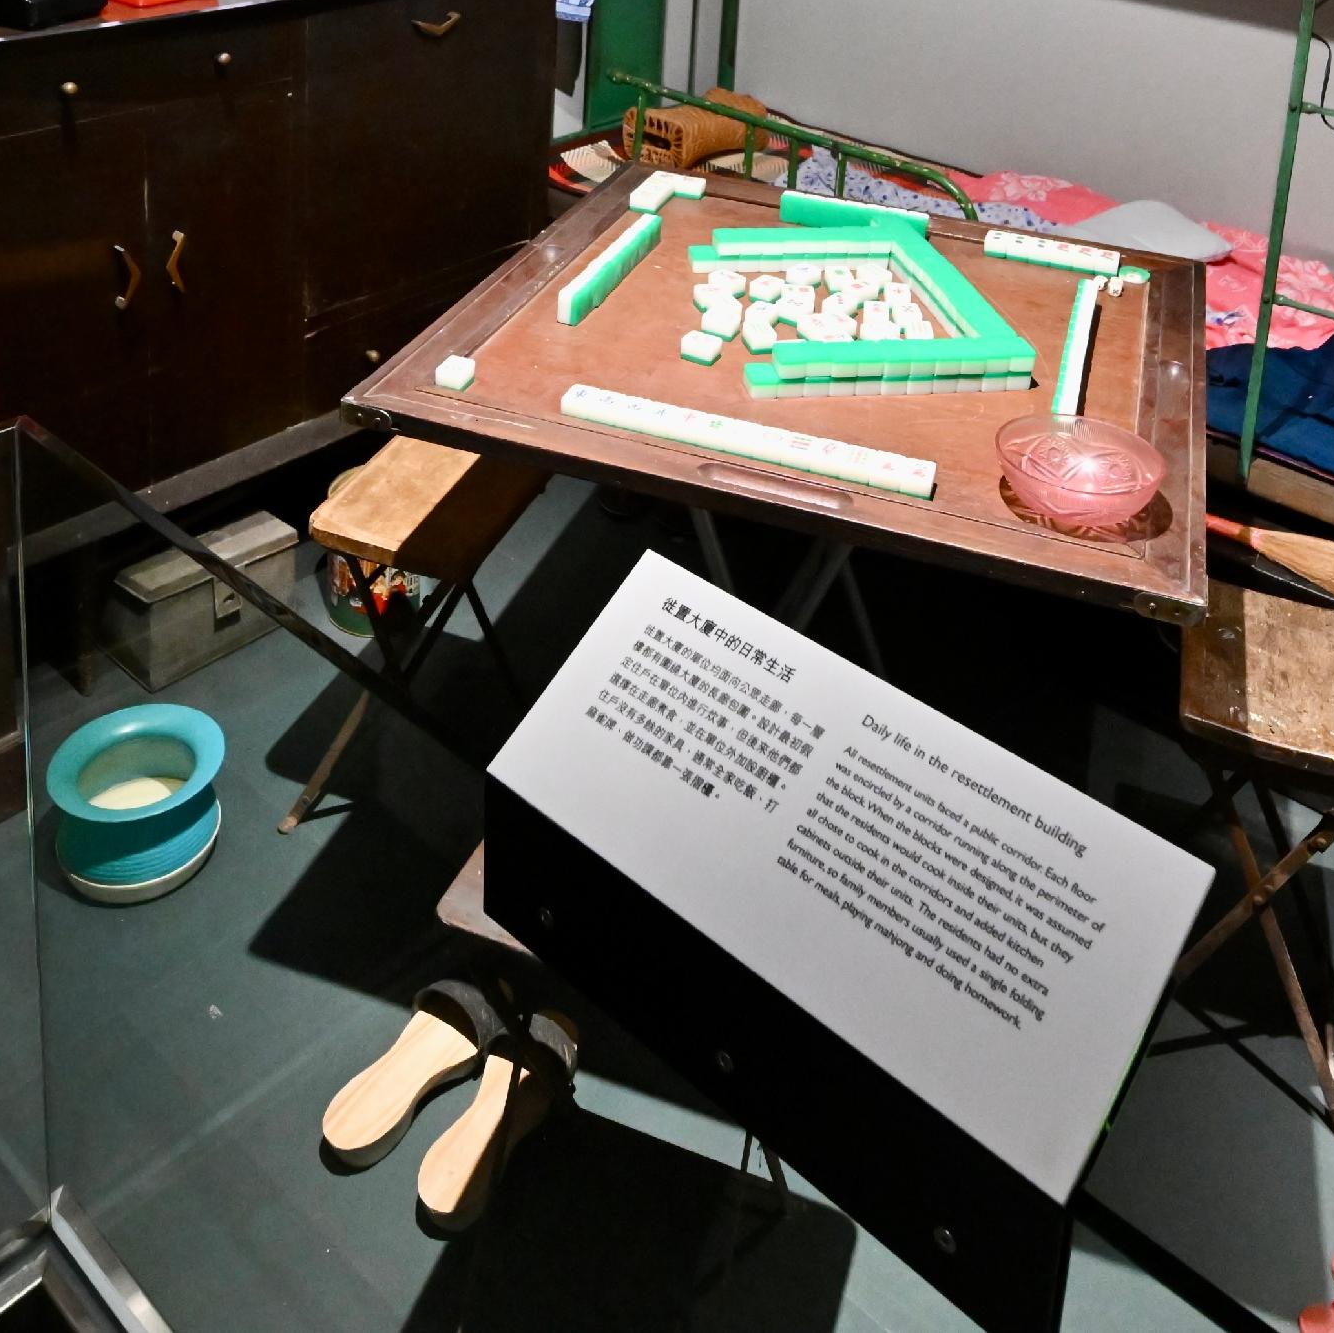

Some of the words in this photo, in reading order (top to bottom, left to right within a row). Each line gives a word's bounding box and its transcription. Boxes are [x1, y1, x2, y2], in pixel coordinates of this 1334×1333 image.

[825, 776, 840, 791] the
[840, 784, 865, 808] block.
[867, 799, 895, 825] When
[895, 820, 912, 836] the
[911, 828, 943, 855] blocks
[944, 851, 968, 871] were
[969, 867, 1014, 902] designed,
[1014, 893, 1024, 907] it
[1025, 902, 1045, 921] was
[1045, 916, 1093, 950] assumed
[835, 762, 852, 777] was
[852, 773, 894, 802] encircled
[892, 794, 905, 811] by
[904, 805, 912, 815] a
[913, 810, 953, 838] corridor
[953, 835, 991, 865] running
[990, 858, 1018, 883] along
[1018, 875, 1037, 891] the
[1036, 887, 1090, 923] perimeter
[1090, 921, 1106, 933] of
[842, 745, 859, 759] All
[857, 754, 913, 793] resettlement
[913, 789, 936, 807] units
[936, 801, 964, 823] faced
[962, 818, 970, 828] a
[968, 824, 1000, 846] public
[1000, 842, 1043, 874] corridor.
[1044, 866, 1069, 889] Each
[1070, 882, 1097, 904] floor
[861, 713, 892, 741] Daily
[893, 732, 912, 752] life
[913, 744, 926, 760] in
[928, 754, 949, 774] the
[950, 769, 1033, 824] resettlement
[1034, 814, 1087, 858] building
[776, 855, 799, 875] table
[798, 868, 815, 884] for
[813, 881, 840, 906] meals,
[839, 900, 874, 930] playing
[873, 922, 915, 958] mahjong
[914, 950, 936, 968] and
[935, 963, 964, 991] doing
[963, 981, 1021, 1030] homework.
[786, 837, 825, 872] furniture,
[826, 866, 839, 879] so
[838, 872, 867, 899] family
[866, 893, 911, 928] members
[911, 923, 944, 952] usually
[945, 945, 971, 968] used
[970, 963, 977, 973] a
[978, 969, 1008, 994] single
[1008, 987, 1045, 1022] folding
[796, 824, 832, 852] cabinets
[832, 847, 866, 874] outside
[866, 869, 890, 889] their
[890, 886, 914, 908] units.
[918, 899, 937, 921] The
[937, 917, 983, 952] residents
[983, 944, 1005, 966] had
[1003, 961, 1019, 976] no
[1020, 973, 1049, 997] extra
[806, 807, 819, 819] all
[817, 815, 844, 837] chose
[844, 832, 855, 844] to
[856, 841, 880, 861] cook
[879, 855, 890, 867] in
[891, 862, 908, 879] the
[908, 875, 954, 908] corridors
[953, 904, 975, 922] and
[973, 917, 1007, 943] added
[1005, 935, 1044, 968] kitchen
[815, 791, 834, 809] that
[834, 804, 850, 819] the
[849, 814, 891, 845] residents
[891, 840, 923, 864] would
[921, 860, 947, 881] cook
[946, 874, 975, 899] inside
[976, 895, 1002, 915] their
[1002, 912, 1028, 936] units,
[1029, 926, 1049, 947] but
[1050, 942, 1074, 964] they
